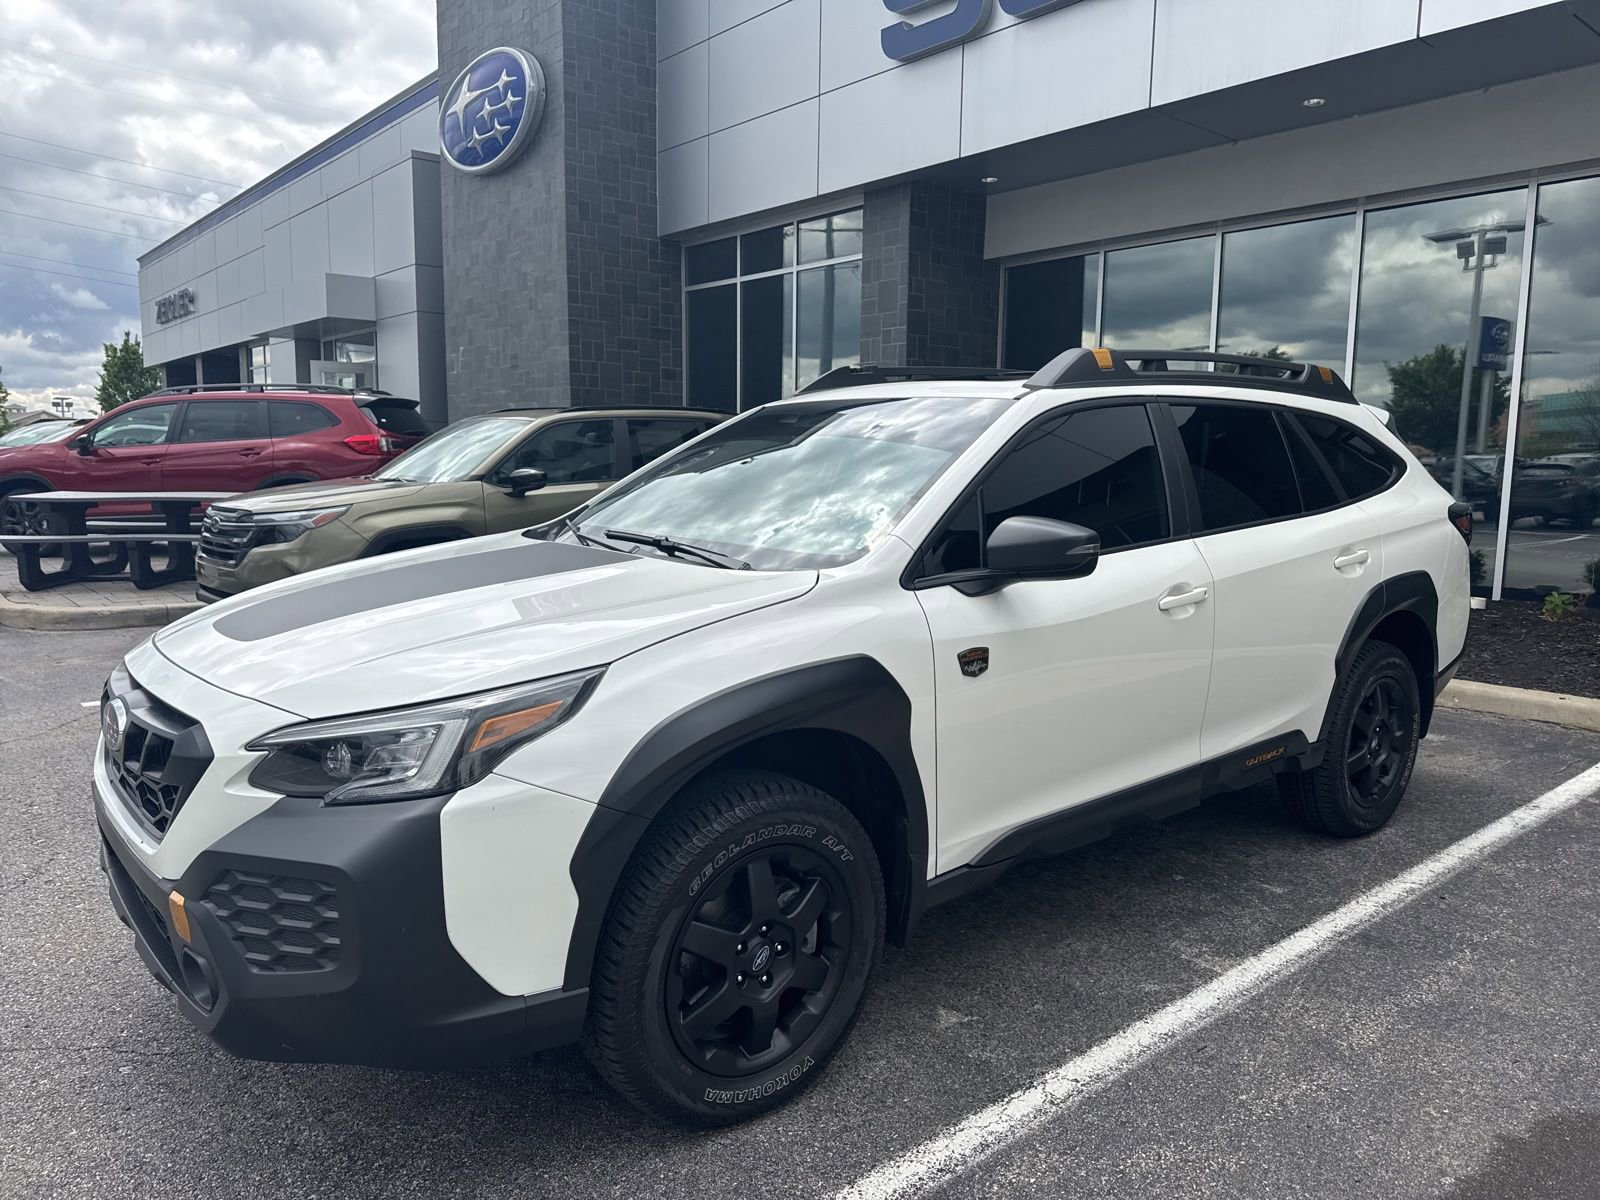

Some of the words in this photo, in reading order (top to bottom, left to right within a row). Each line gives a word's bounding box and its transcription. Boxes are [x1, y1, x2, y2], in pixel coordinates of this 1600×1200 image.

[1246, 747, 1285, 767] OUTBACK
[689, 824, 817, 896] GEOLANDAR
[822, 835, 854, 862] A/T
[704, 1055, 815, 1104] YOKOHAMA
